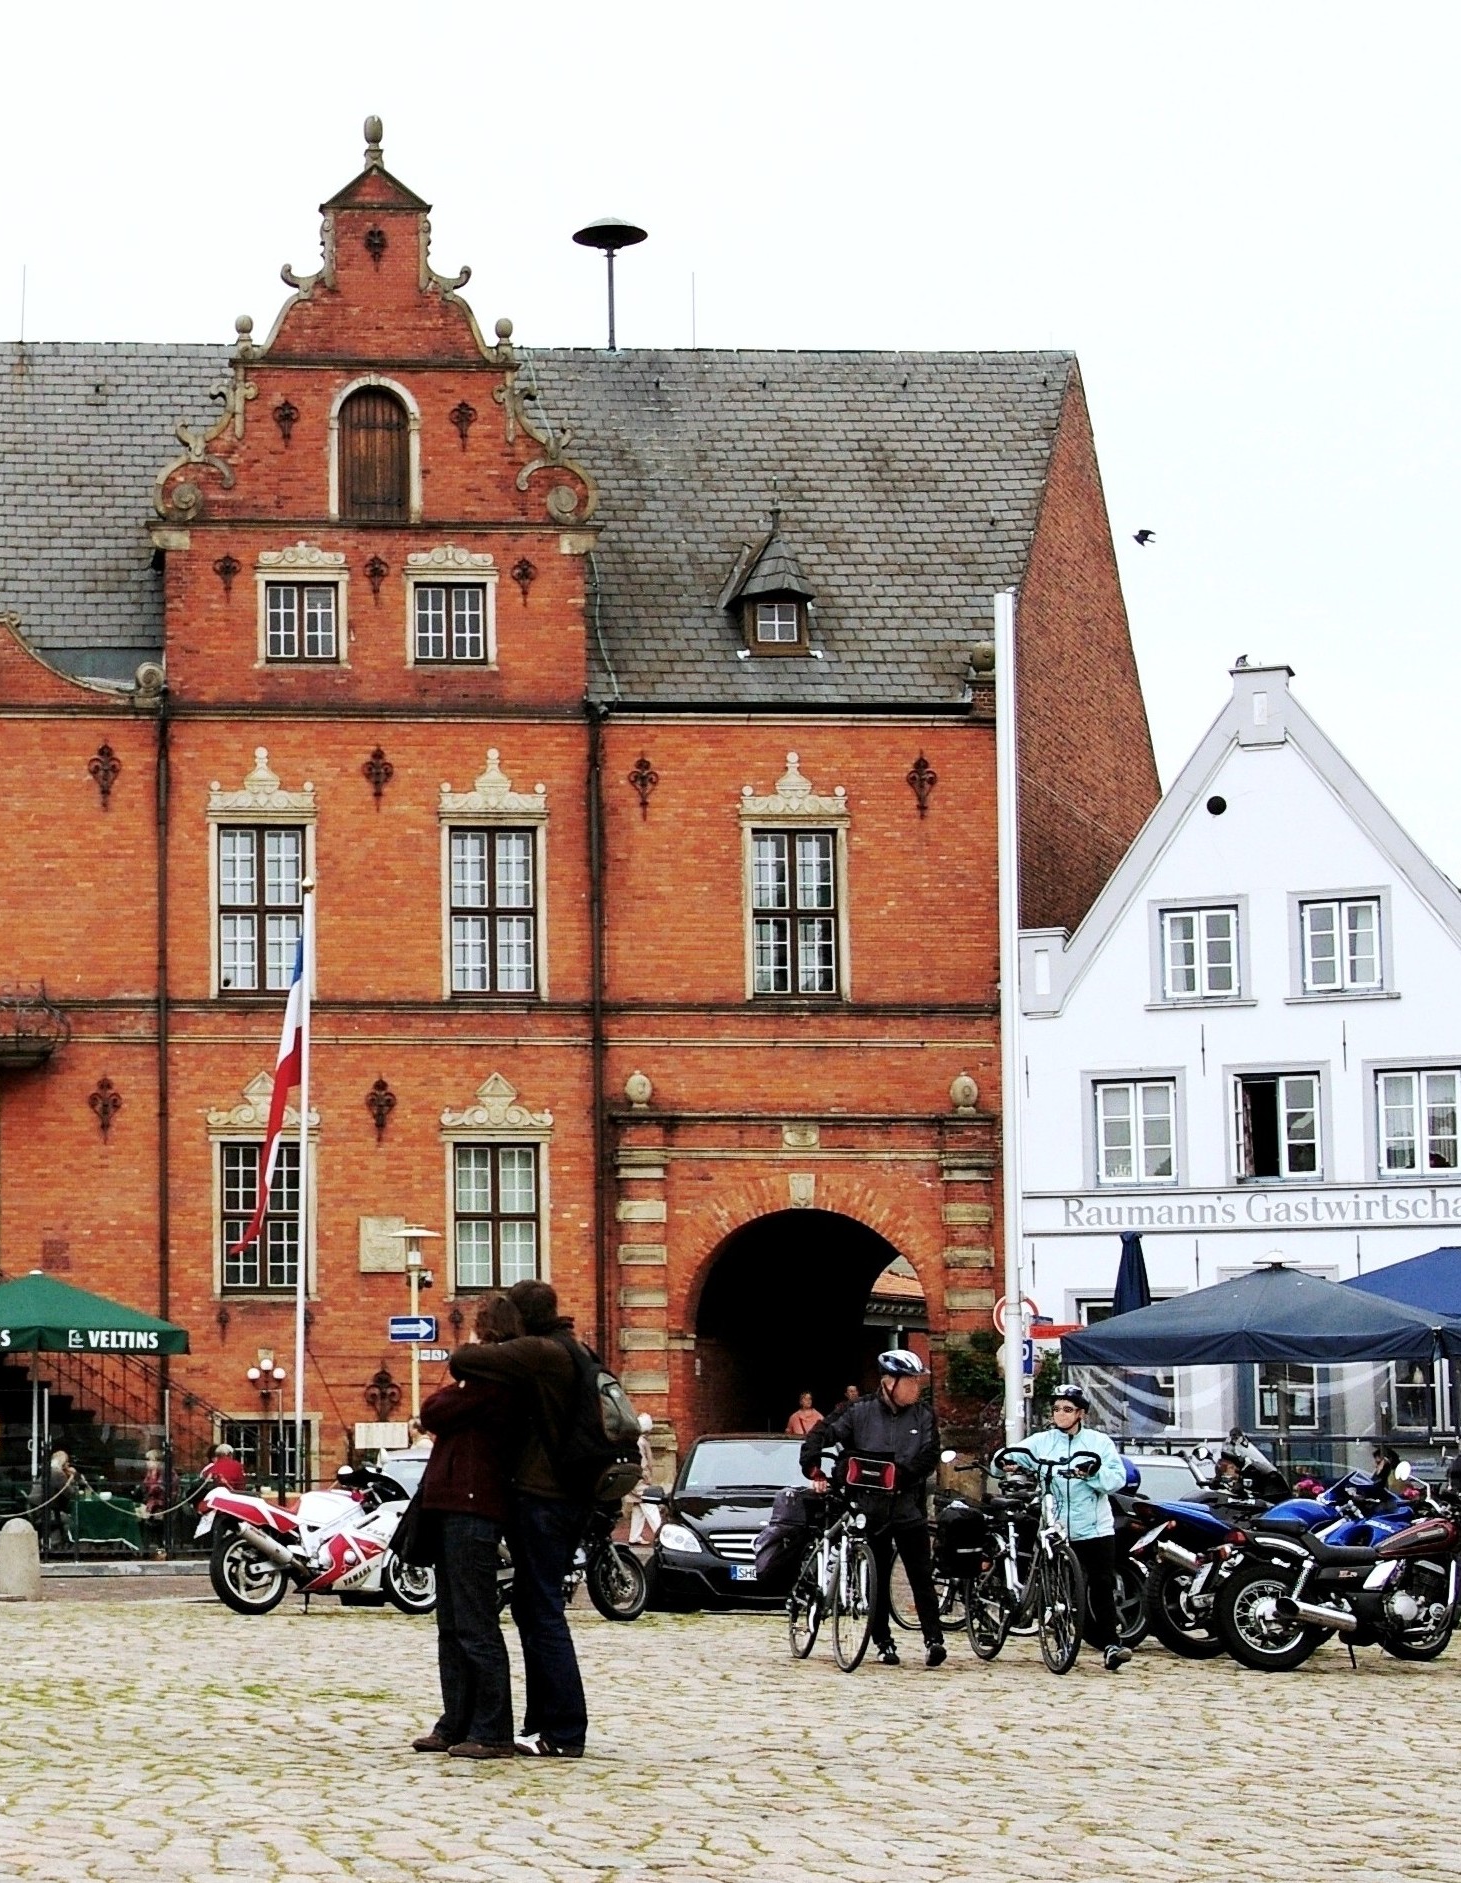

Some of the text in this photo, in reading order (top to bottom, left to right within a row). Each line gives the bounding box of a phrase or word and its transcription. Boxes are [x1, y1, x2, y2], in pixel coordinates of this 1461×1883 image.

[1062, 1195, 1237, 1227] Raumann's
[88, 1330, 159, 1349] VELTINS
[342, 1564, 372, 1587] YAMAHA
